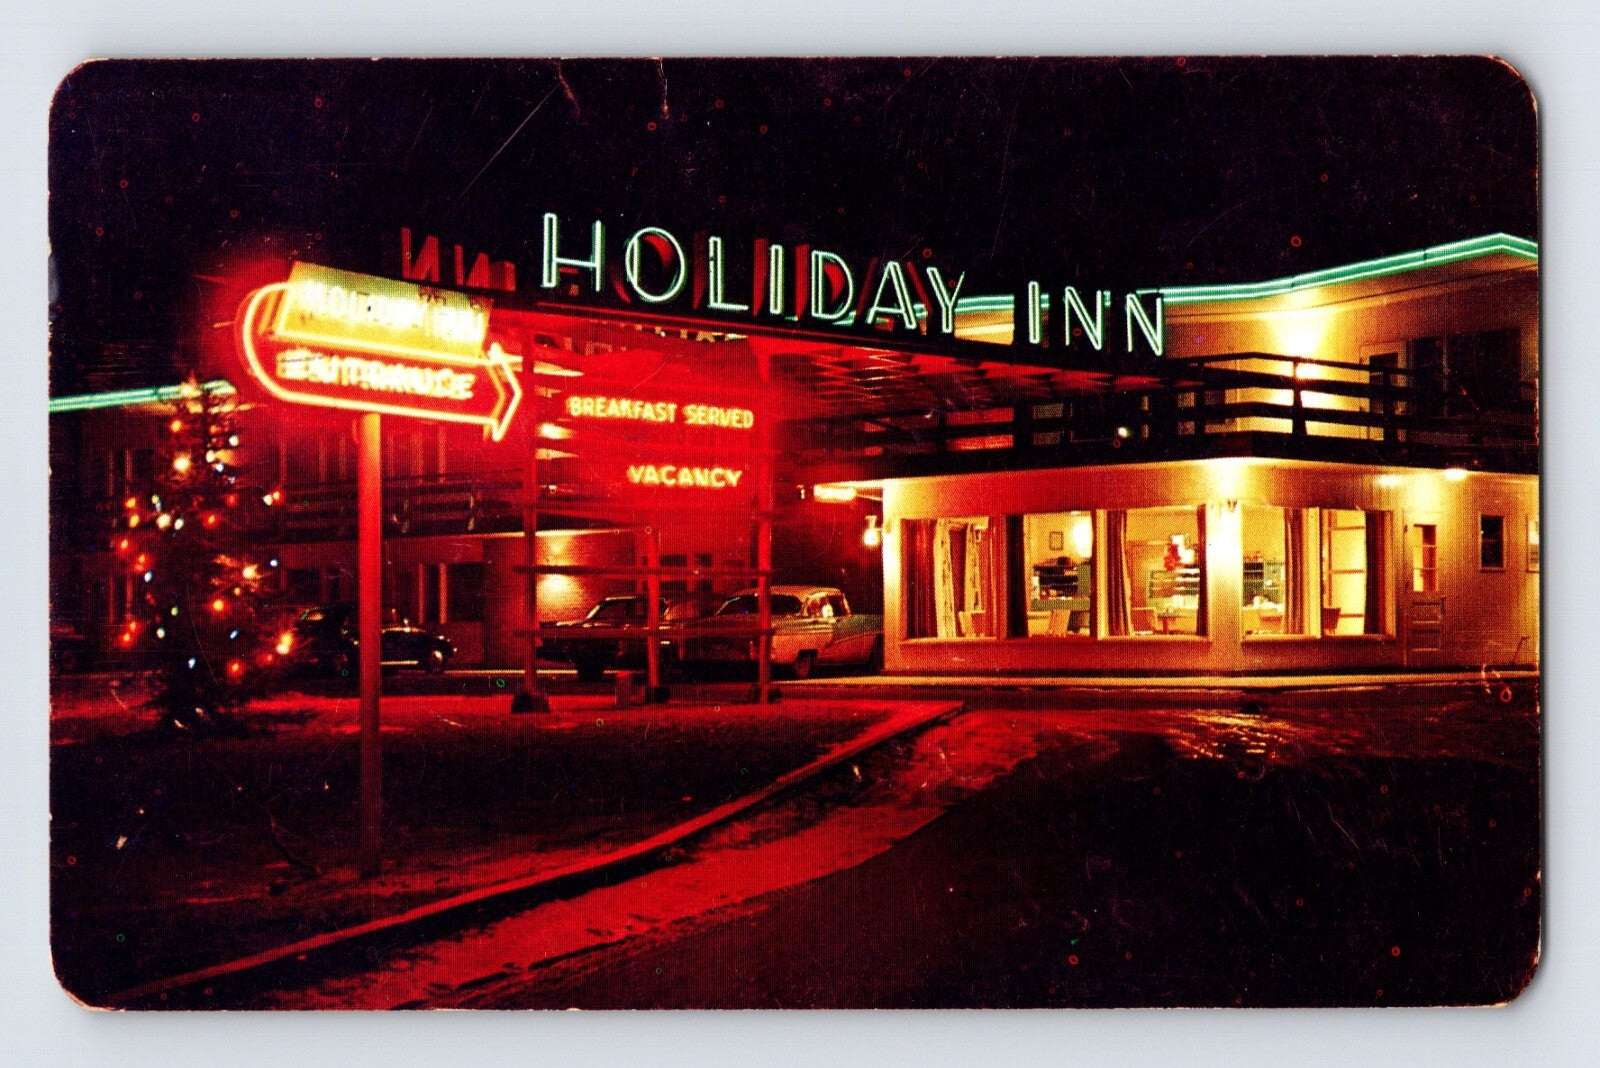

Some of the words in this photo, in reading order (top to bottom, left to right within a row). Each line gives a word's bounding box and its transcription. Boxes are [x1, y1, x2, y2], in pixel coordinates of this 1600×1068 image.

[541, 212, 966, 334] HOLIDAY
[1027, 279, 1164, 356] INN
[566, 396, 677, 423] BREAKFAST
[682, 404, 754, 429] SERVED
[627, 464, 742, 488] VACANCY
